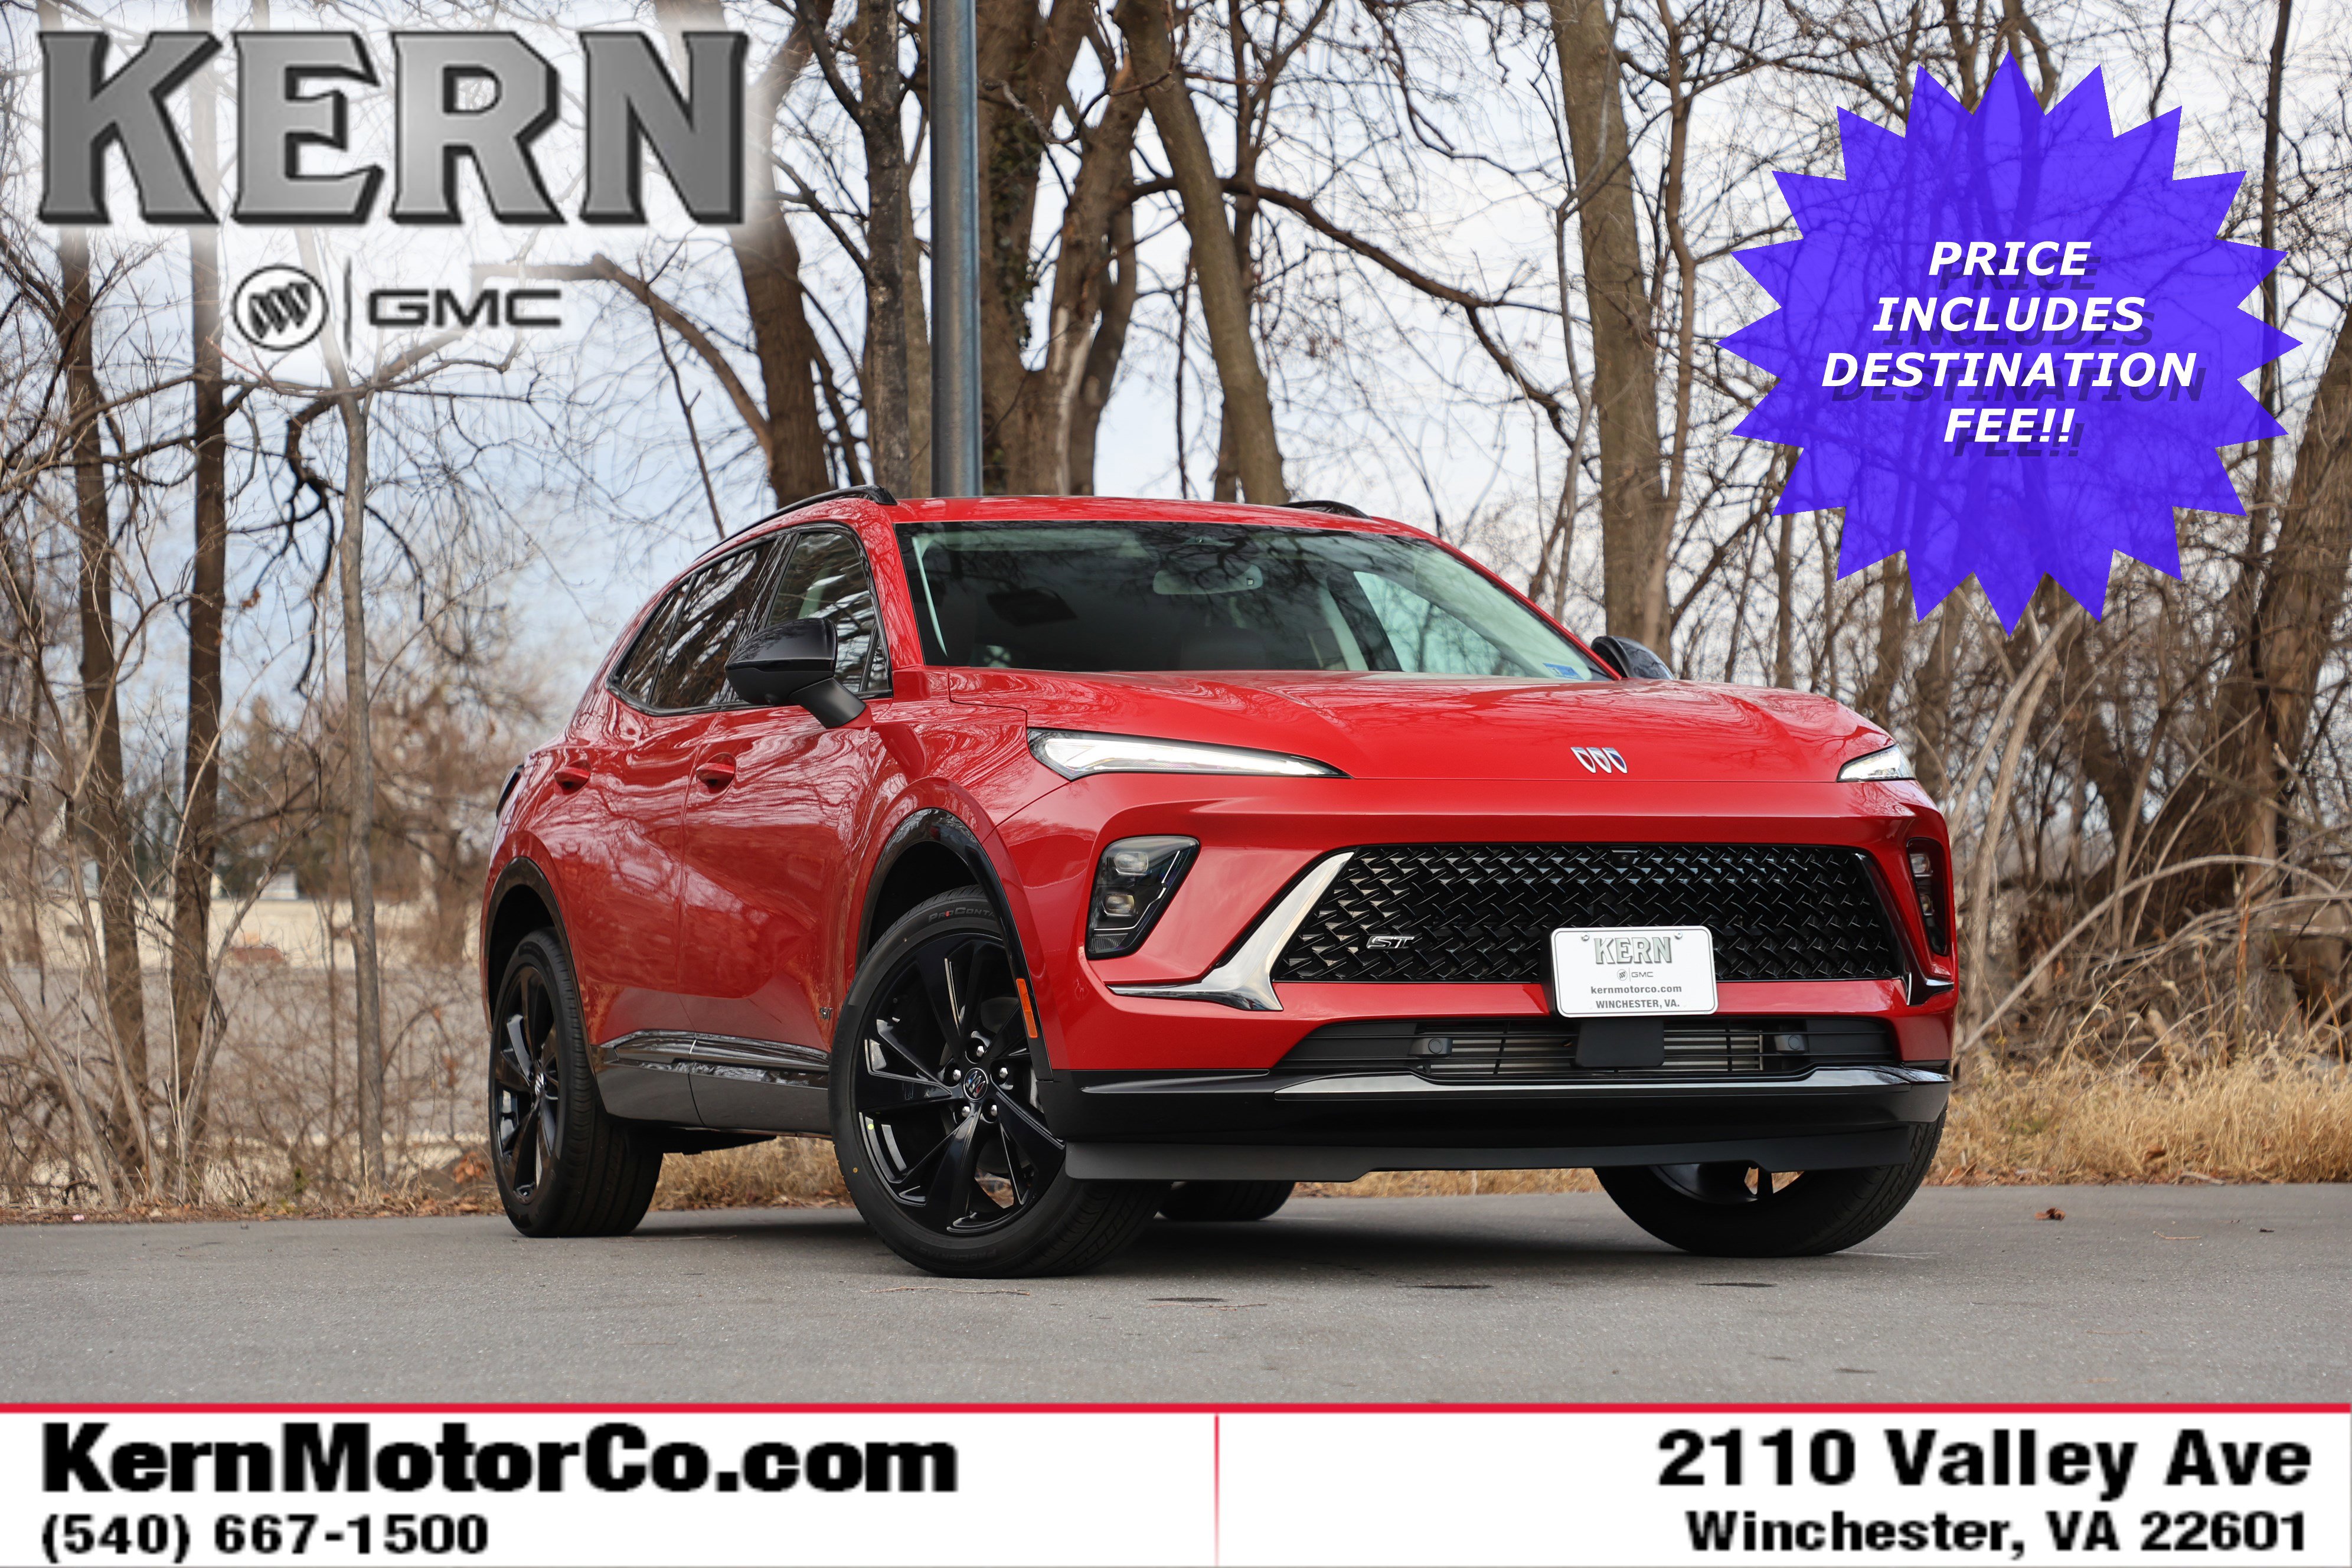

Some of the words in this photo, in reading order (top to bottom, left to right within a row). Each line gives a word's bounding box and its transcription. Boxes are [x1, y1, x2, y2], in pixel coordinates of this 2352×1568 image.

[1594, 937, 1672, 965] KERN
[1590, 985, 1683, 994] kernmotorco.com
[1596, 999, 1662, 1009] WINCHESTER,
[1664, 999, 1680, 1007] VA.
